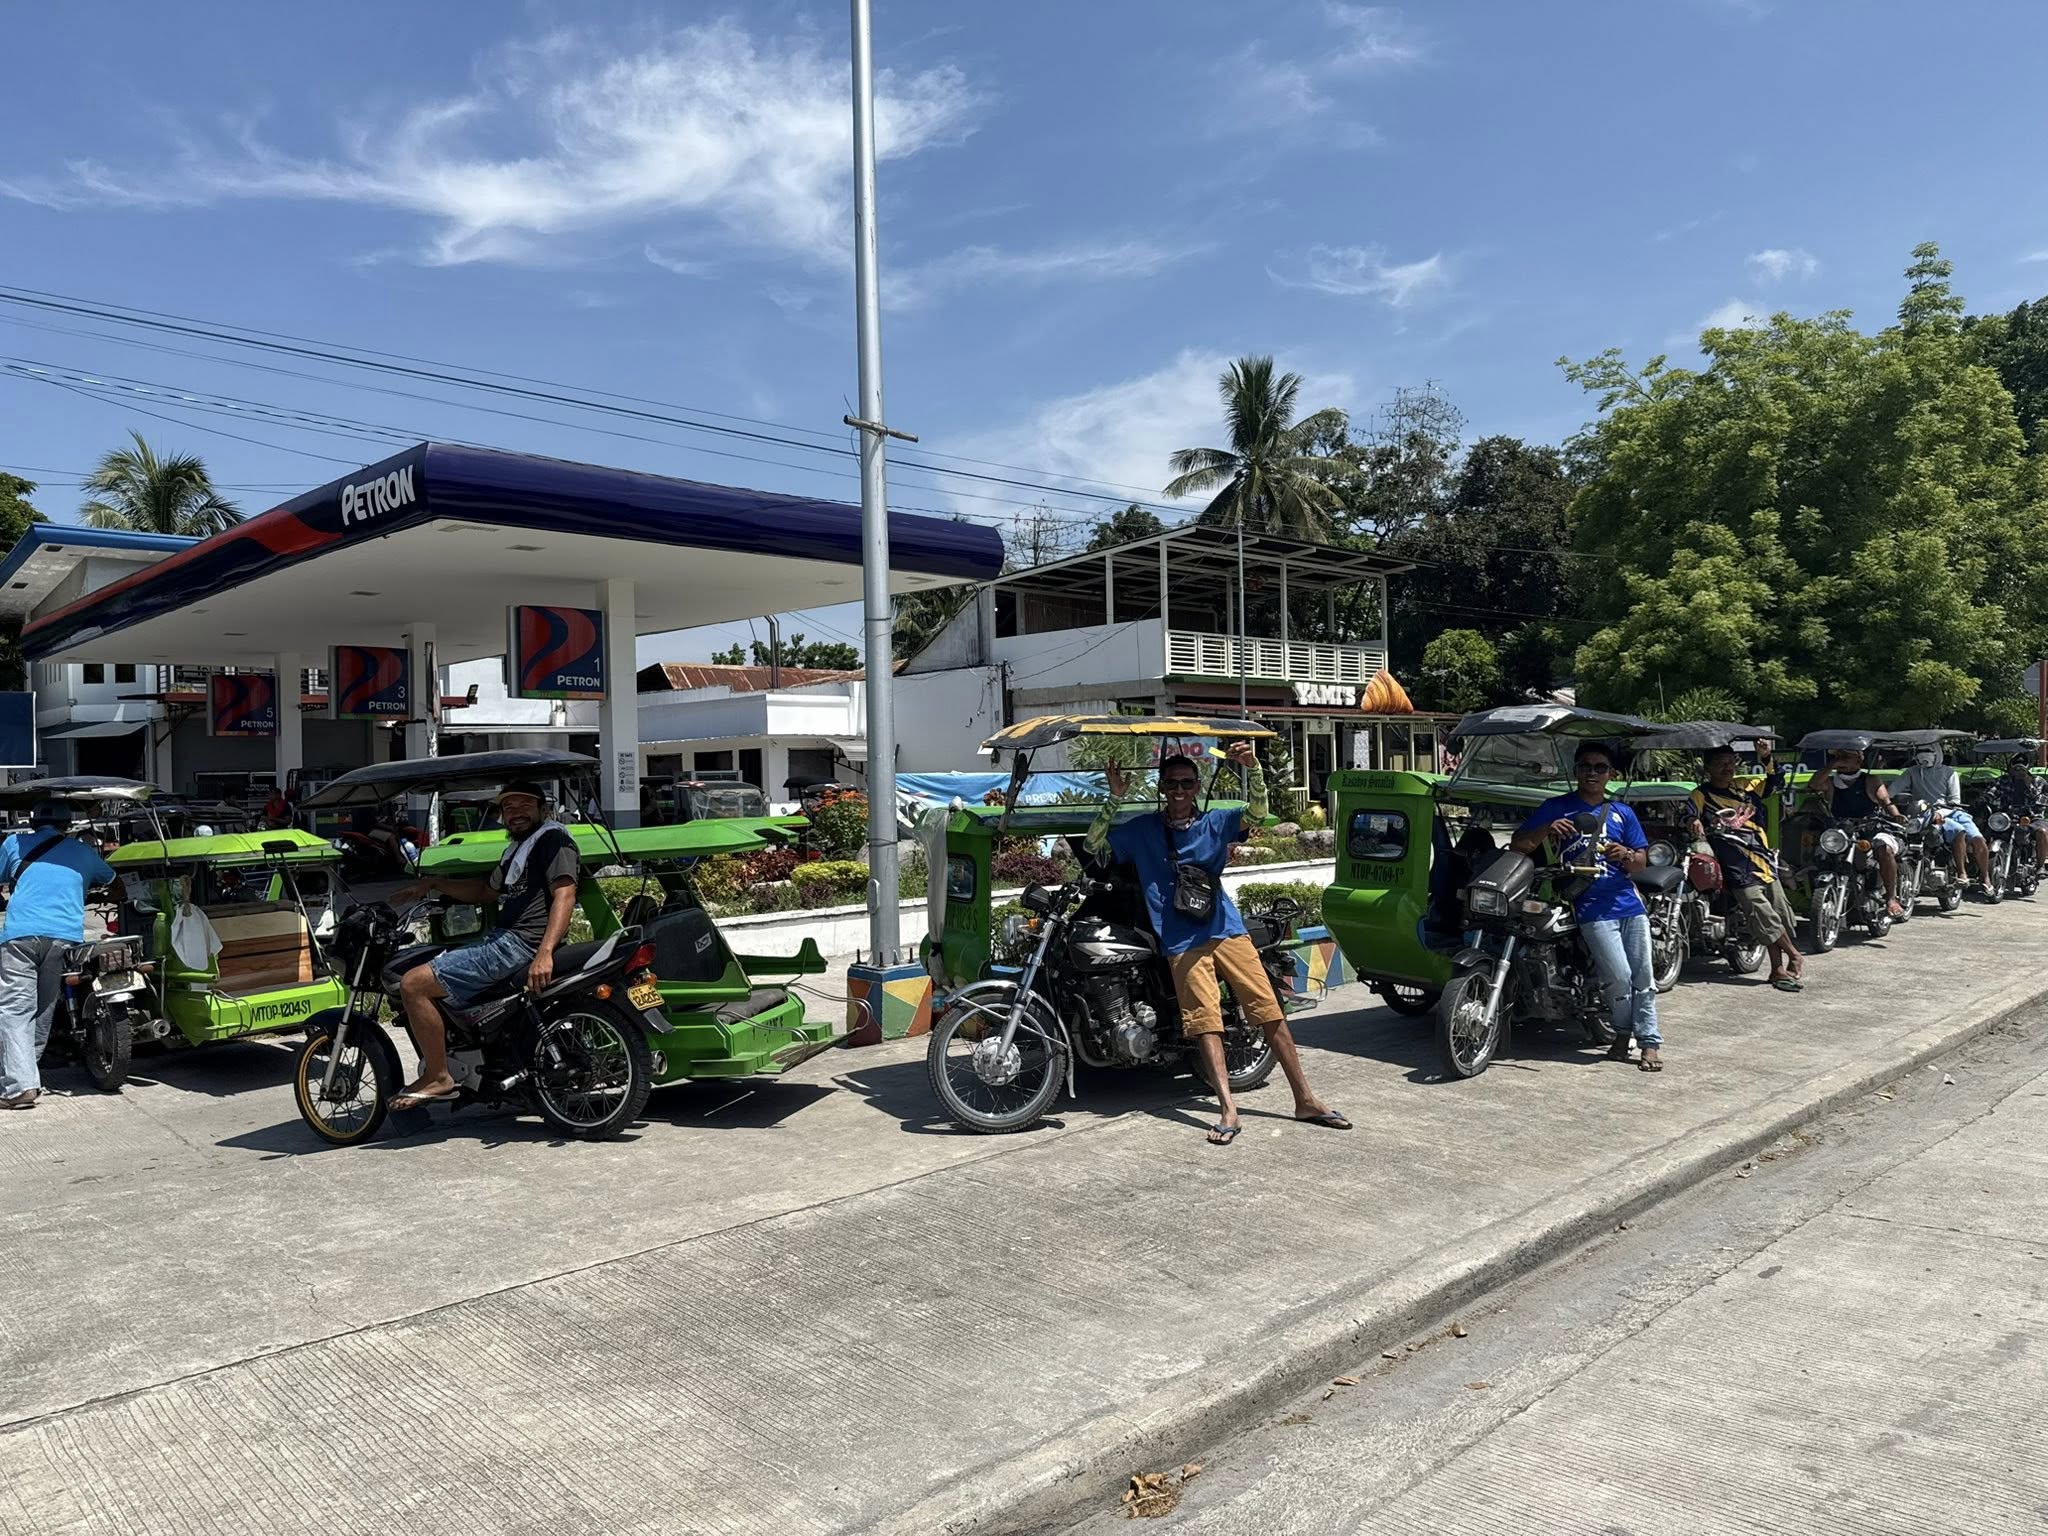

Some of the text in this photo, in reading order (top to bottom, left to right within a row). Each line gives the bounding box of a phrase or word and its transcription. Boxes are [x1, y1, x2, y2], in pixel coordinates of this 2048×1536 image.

[341, 463, 416, 526] PETRON
[593, 657, 600, 672] 1
[557, 675, 600, 687] PETRON
[398, 686, 406, 698] 3
[1295, 682, 1356, 706] YAMI'S
[368, 701, 406, 711] PETRON
[266, 707, 274, 718] 5
[241, 720, 274, 728] PETRON
[1190, 897, 1206, 910] CAT
[1090, 952, 1137, 965] TMX
